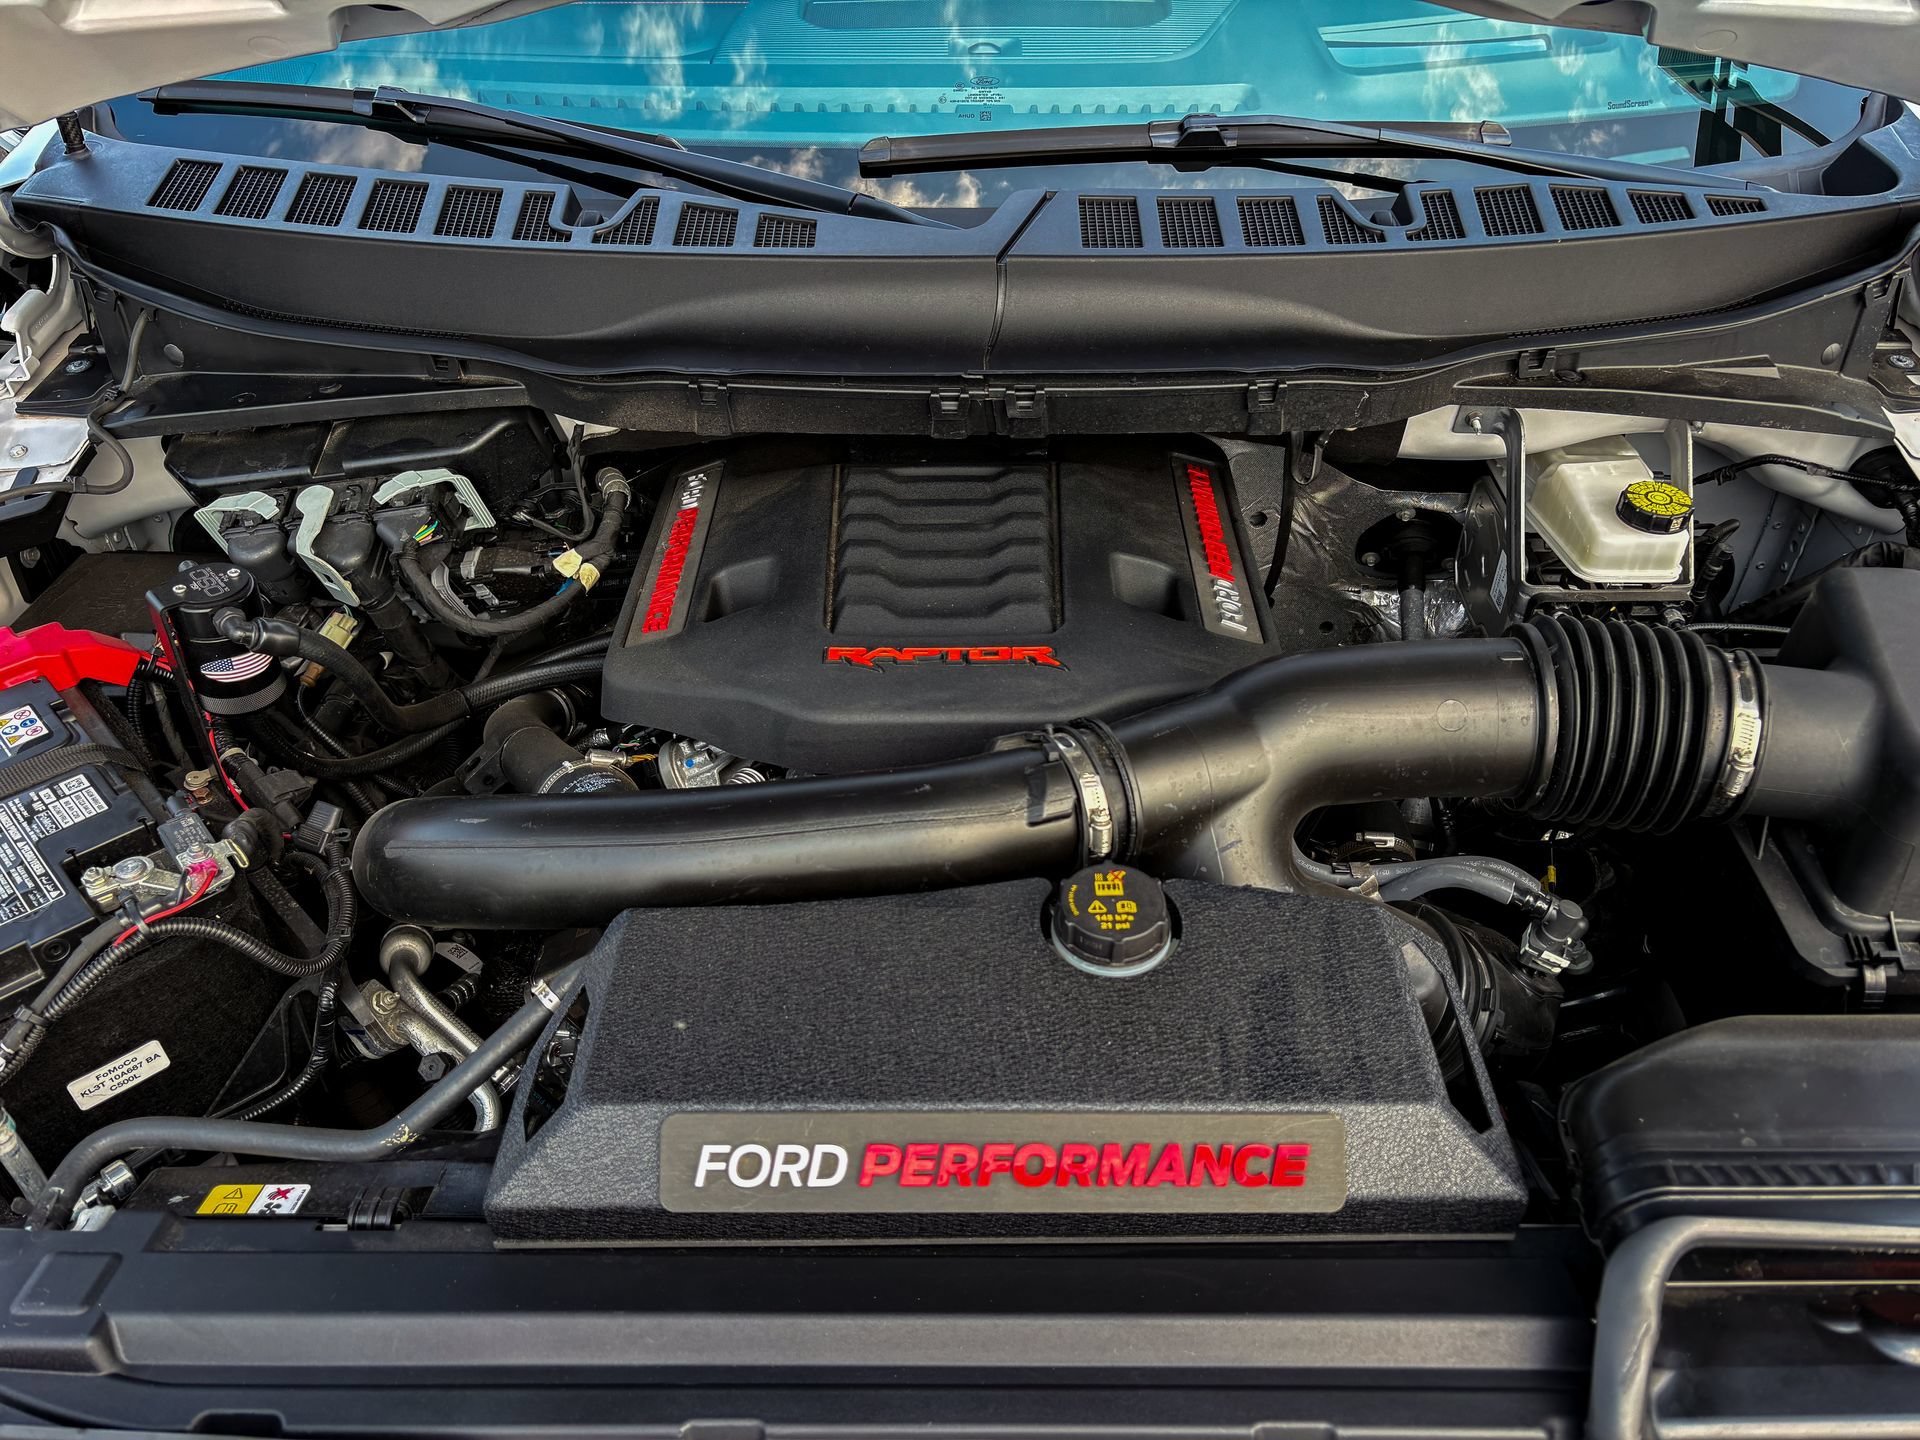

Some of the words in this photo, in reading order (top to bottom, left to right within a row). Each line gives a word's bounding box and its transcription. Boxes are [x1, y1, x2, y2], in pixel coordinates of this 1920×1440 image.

[1607, 99, 1649, 110] SoundScreen
[1187, 463, 1236, 583] PERFORMANCE
[641, 507, 700, 634] PERFORMANCE
[1213, 579, 1248, 632] FORD
[824, 646, 1069, 671] RAPTOR
[80, 1081, 106, 1098] KL3T
[109, 1061, 144, 1083] 10A687
[145, 1053, 161, 1064] BA
[95, 1056, 138, 1081] FoMoCo
[109, 1073, 141, 1091] C500L
[695, 1144, 848, 1187] FORD
[858, 1143, 1311, 1188] PERFORMANCE
